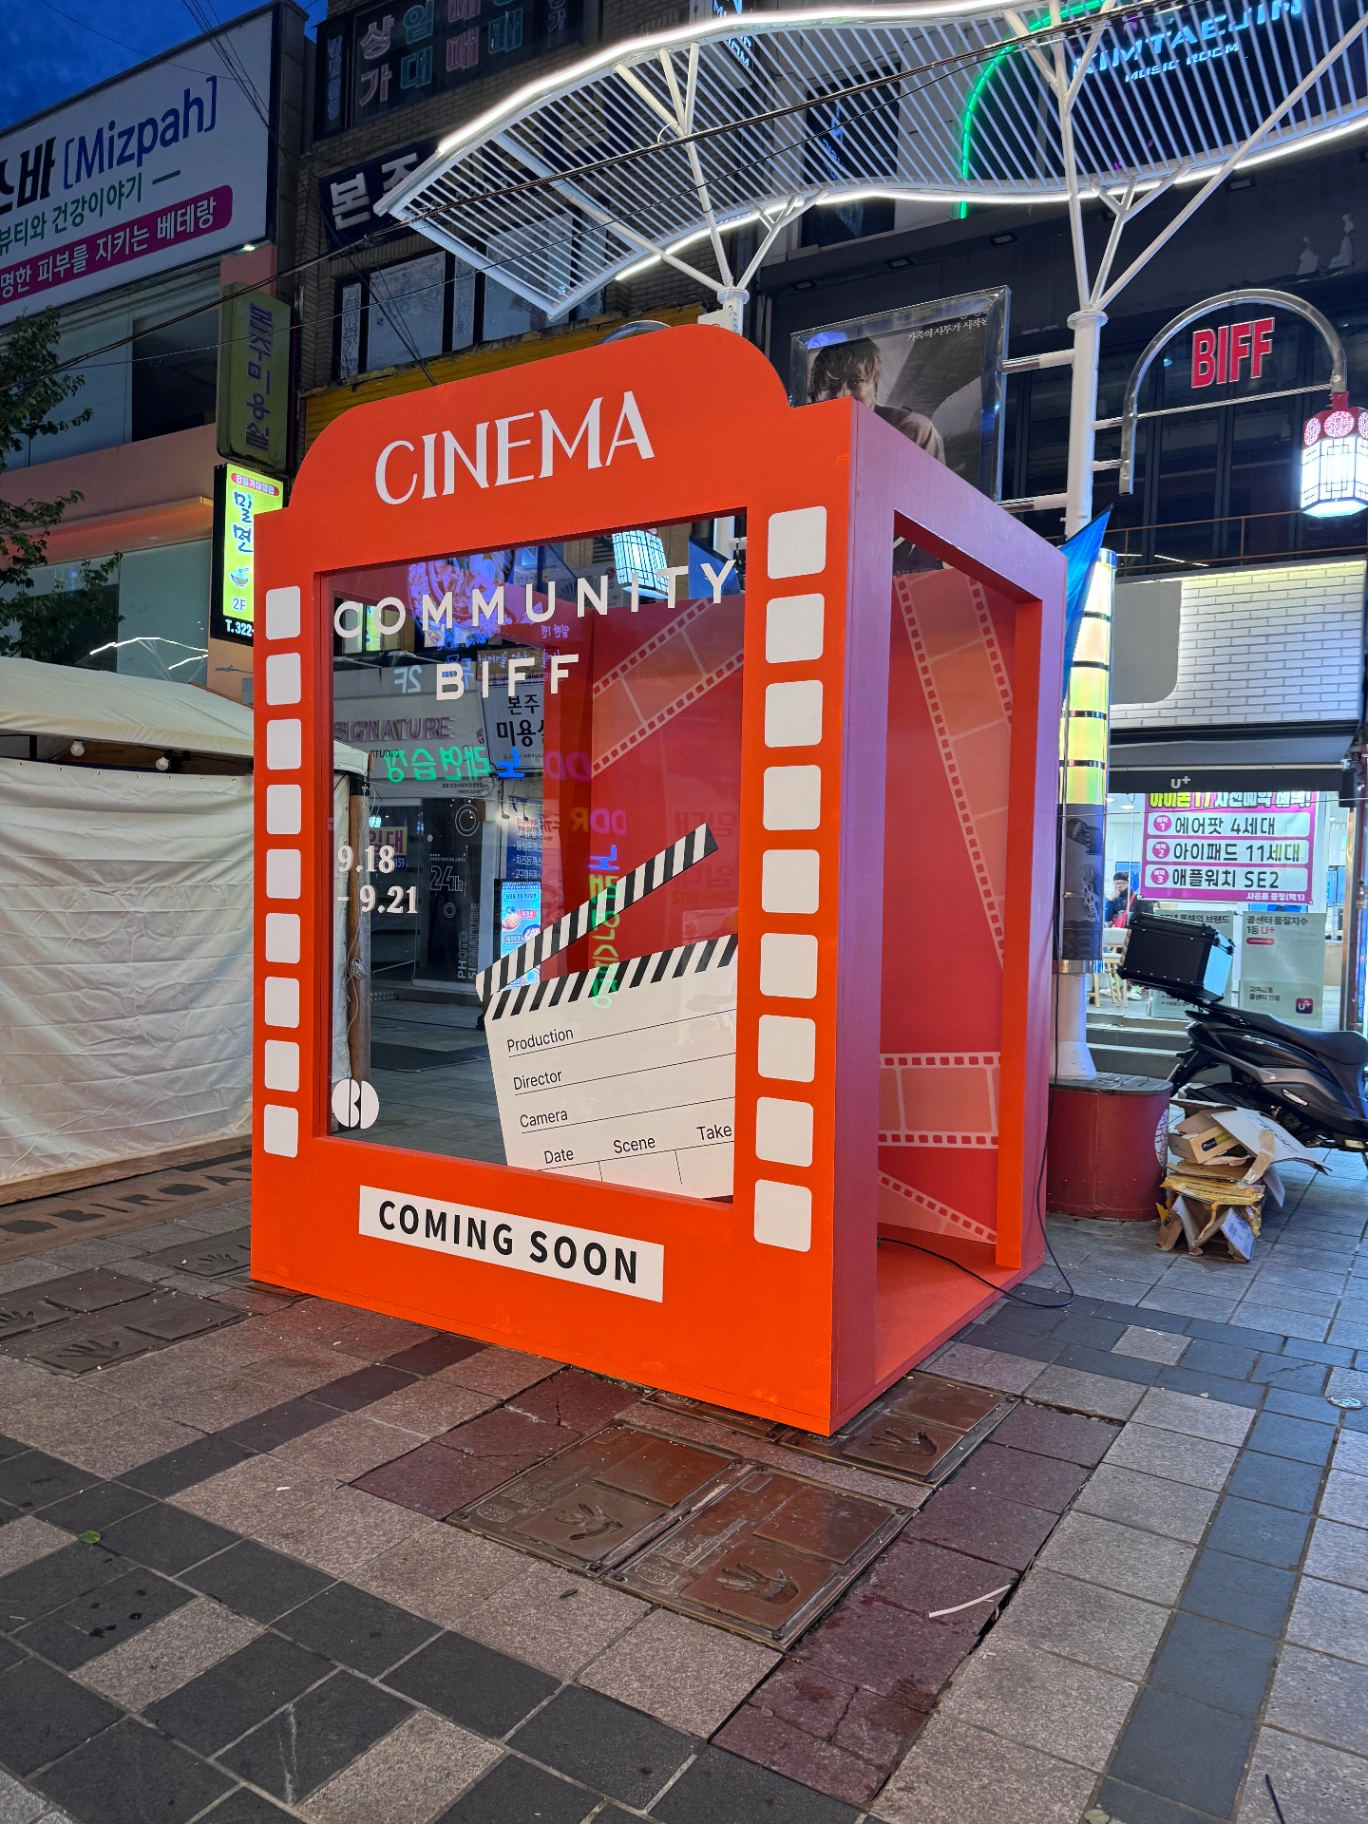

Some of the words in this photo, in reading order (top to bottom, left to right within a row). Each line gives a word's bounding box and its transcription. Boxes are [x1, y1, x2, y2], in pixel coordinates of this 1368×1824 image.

[1072, 0, 1302, 77] KIMTAEJIN
[359, 14, 394, 107] 상가
[400, 0, 435, 89] 임대
[1124, 59, 1179, 82] MUSIC
[37, 243, 89, 282] 피부를
[95, 225, 150, 262] 지키는
[157, 196, 217, 240] 베테랑
[1192, 318, 1274, 388] BIFF
[245, 301, 273, 452] 본주미용실
[375, 391, 655, 505] CINEMA
[232, 597, 247, 611] 2F
[333, 559, 737, 639] COMMUNITY
[436, 653, 580, 701] BIFF
[507, 694, 540, 715] 본주
[333, 715, 452, 742] SIGNATURE
[369, 748, 400, 758] STUDIO
[1170, 775, 1191, 789] U+
[1175, 817, 1224, 835] 에어팟
[1230, 817, 1276, 835] 4세대
[336, 844, 396, 874] 9.18
[1173, 843, 1238, 861] 아이패드
[1245, 843, 1300, 862] 11세대
[429, 864, 464, 892] 24h
[1172, 868, 1236, 888] 애플워치
[1243, 870, 1280, 889] SE2
[358, 884, 419, 914] 9.21
[1205, 914, 1230, 924] 브랜드
[1260, 926, 1276, 935] U+
[457, 930, 469, 979] PHOTO
[467, 902, 480, 980] SIGNATURE
[1298, 1001, 1312, 1011] U+
[506, 1027, 574, 1053] Production
[513, 1070, 563, 1091] Director
[519, 1108, 569, 1128] Camera
[543, 1148, 574, 1165] Date
[612, 1135, 656, 1154] Scene
[696, 1123, 732, 1141] Take
[378, 1200, 513, 1257] COMING
[528, 1229, 638, 1285] SOON
